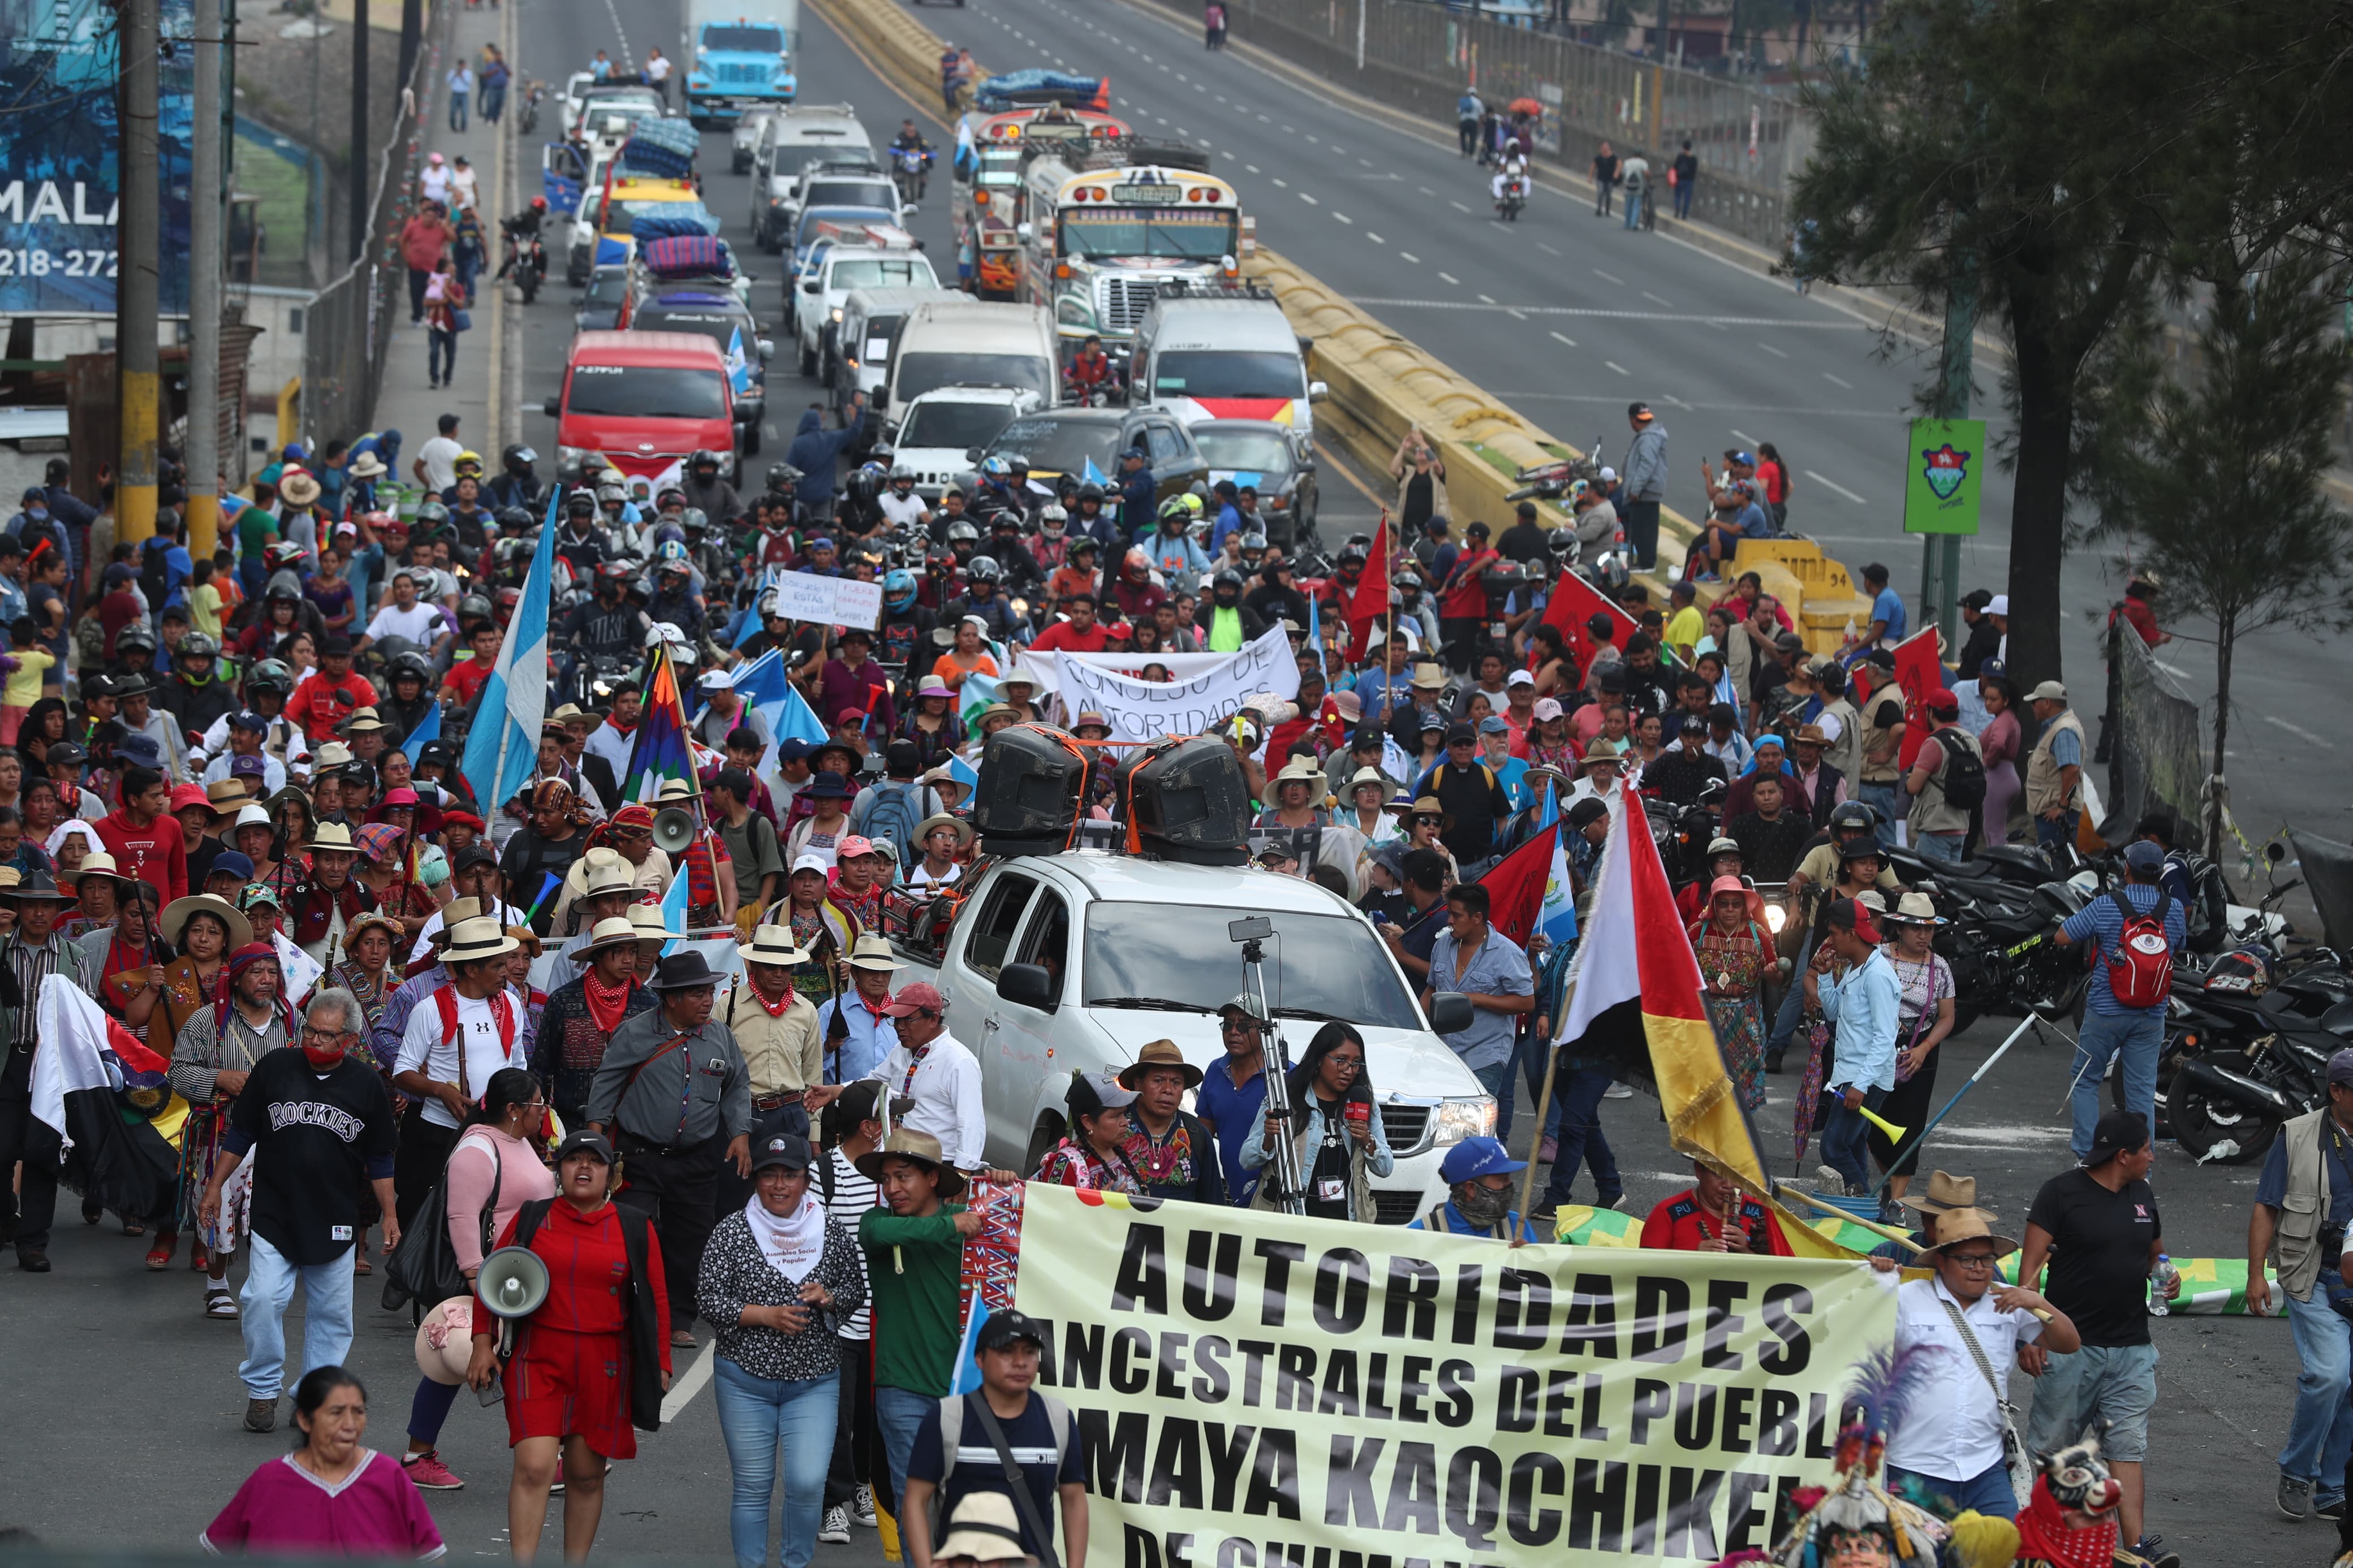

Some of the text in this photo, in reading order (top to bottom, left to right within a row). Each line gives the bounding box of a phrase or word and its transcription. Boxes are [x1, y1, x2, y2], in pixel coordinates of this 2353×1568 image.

[0, 179, 119, 226] MAL
[268, 1101, 365, 1142] ROCKIES
[2333, 1133, 2342, 1147] Nikon
[1675, 1203, 1691, 1216] PU
[765, 1248, 796, 1258] Asamblea
[1110, 1222, 1814, 1376] AUTORIDADES
[1027, 1318, 1476, 1429] ANCESTRALES
[1496, 1364, 1609, 1441] DEL
[1076, 1408, 1302, 1521] MAYA
